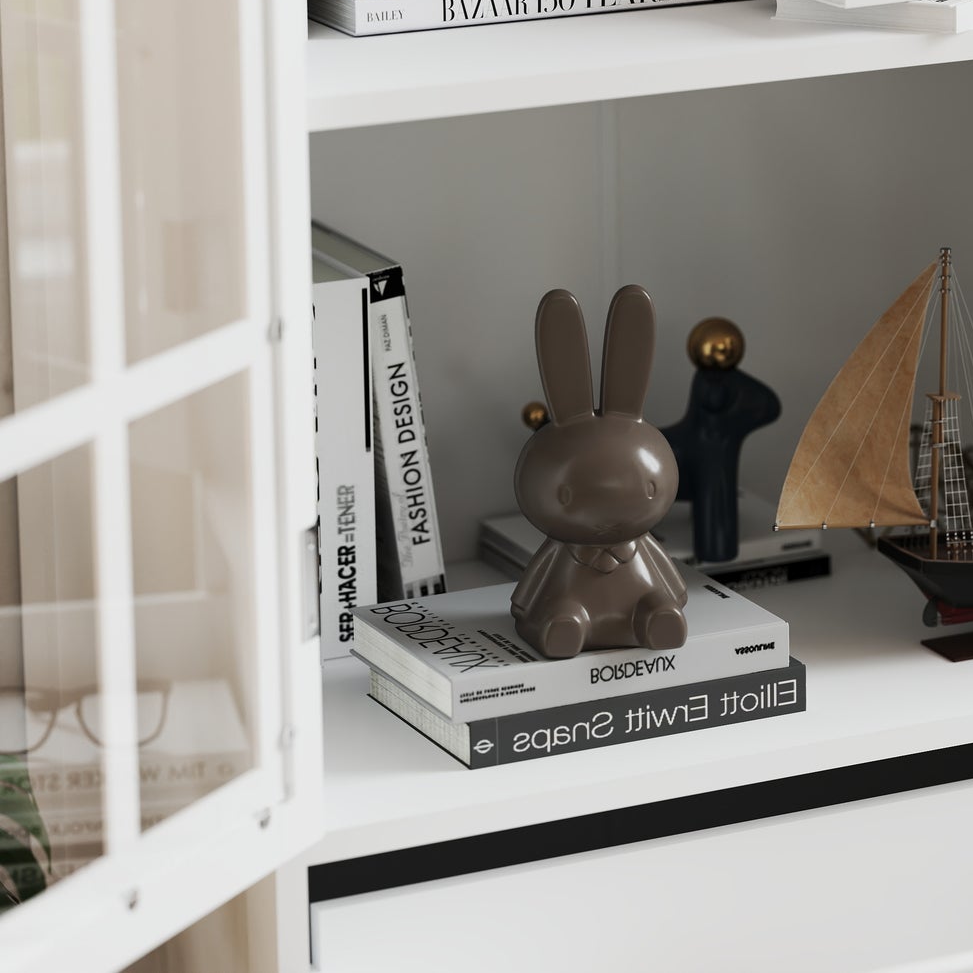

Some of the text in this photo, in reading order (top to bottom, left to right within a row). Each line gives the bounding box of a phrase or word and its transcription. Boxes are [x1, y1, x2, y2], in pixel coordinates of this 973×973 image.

[366, 9, 404, 23] BAILEY
[387, 362, 431, 546] FASHION DESIGN
